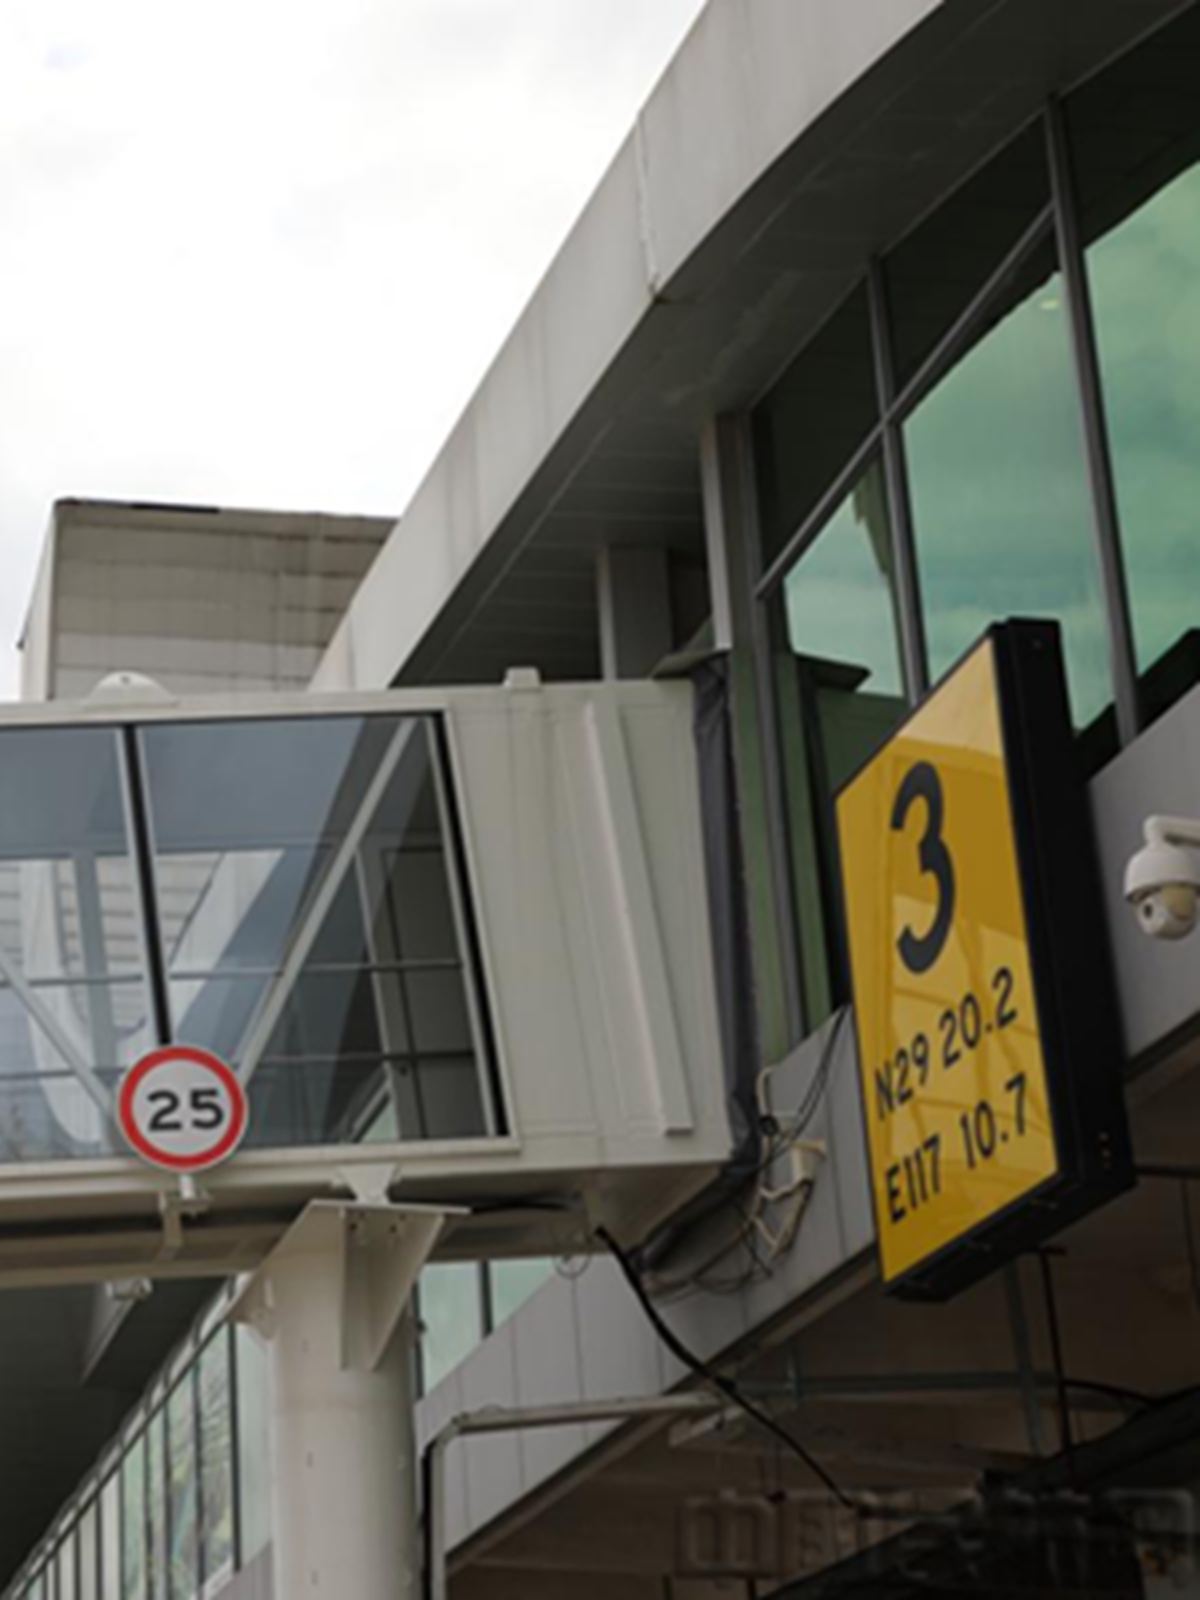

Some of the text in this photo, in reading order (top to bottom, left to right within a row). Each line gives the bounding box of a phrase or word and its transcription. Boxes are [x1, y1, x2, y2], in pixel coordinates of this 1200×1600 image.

[890, 761, 957, 974] 3
[147, 1088, 224, 1131] 25
[875, 966, 1017, 1121] N29 20.2
[886, 1071, 1025, 1224] E117 10.7
